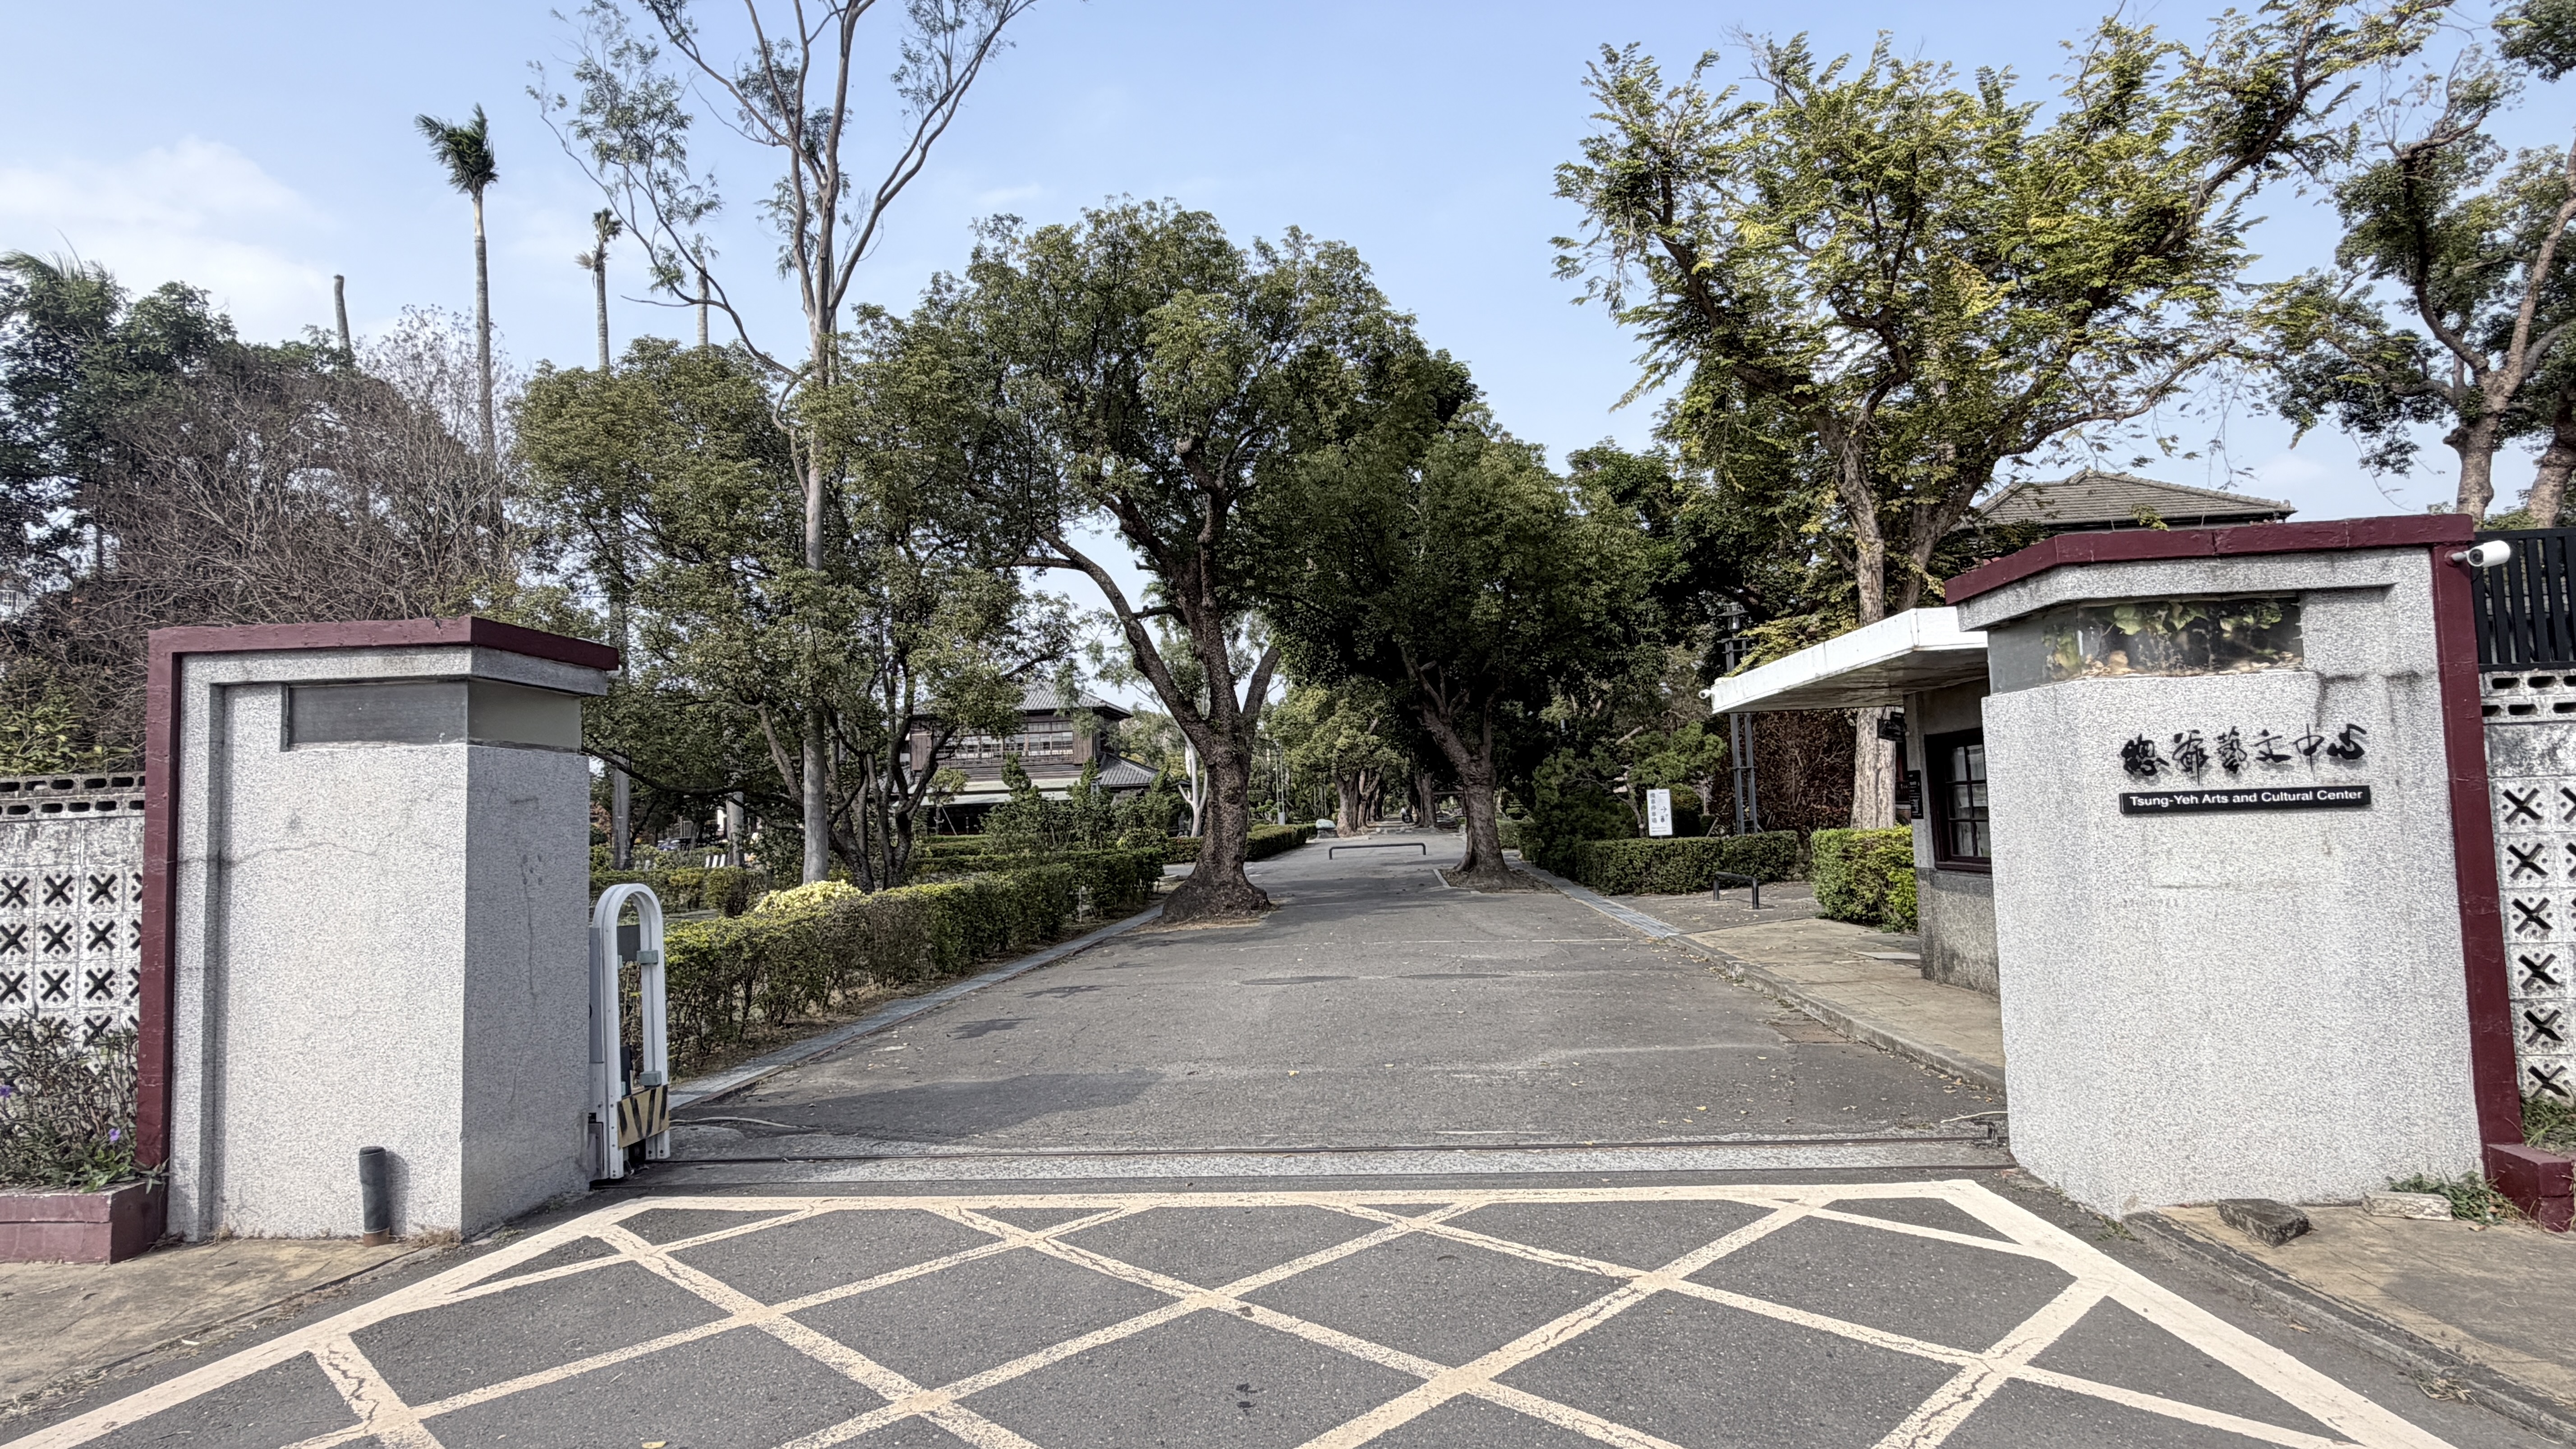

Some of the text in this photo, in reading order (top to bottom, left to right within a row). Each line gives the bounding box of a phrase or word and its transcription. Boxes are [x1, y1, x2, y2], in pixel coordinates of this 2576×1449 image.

[2130, 790, 2363, 807] Tsung-Yeh Arts and Cultural Center
